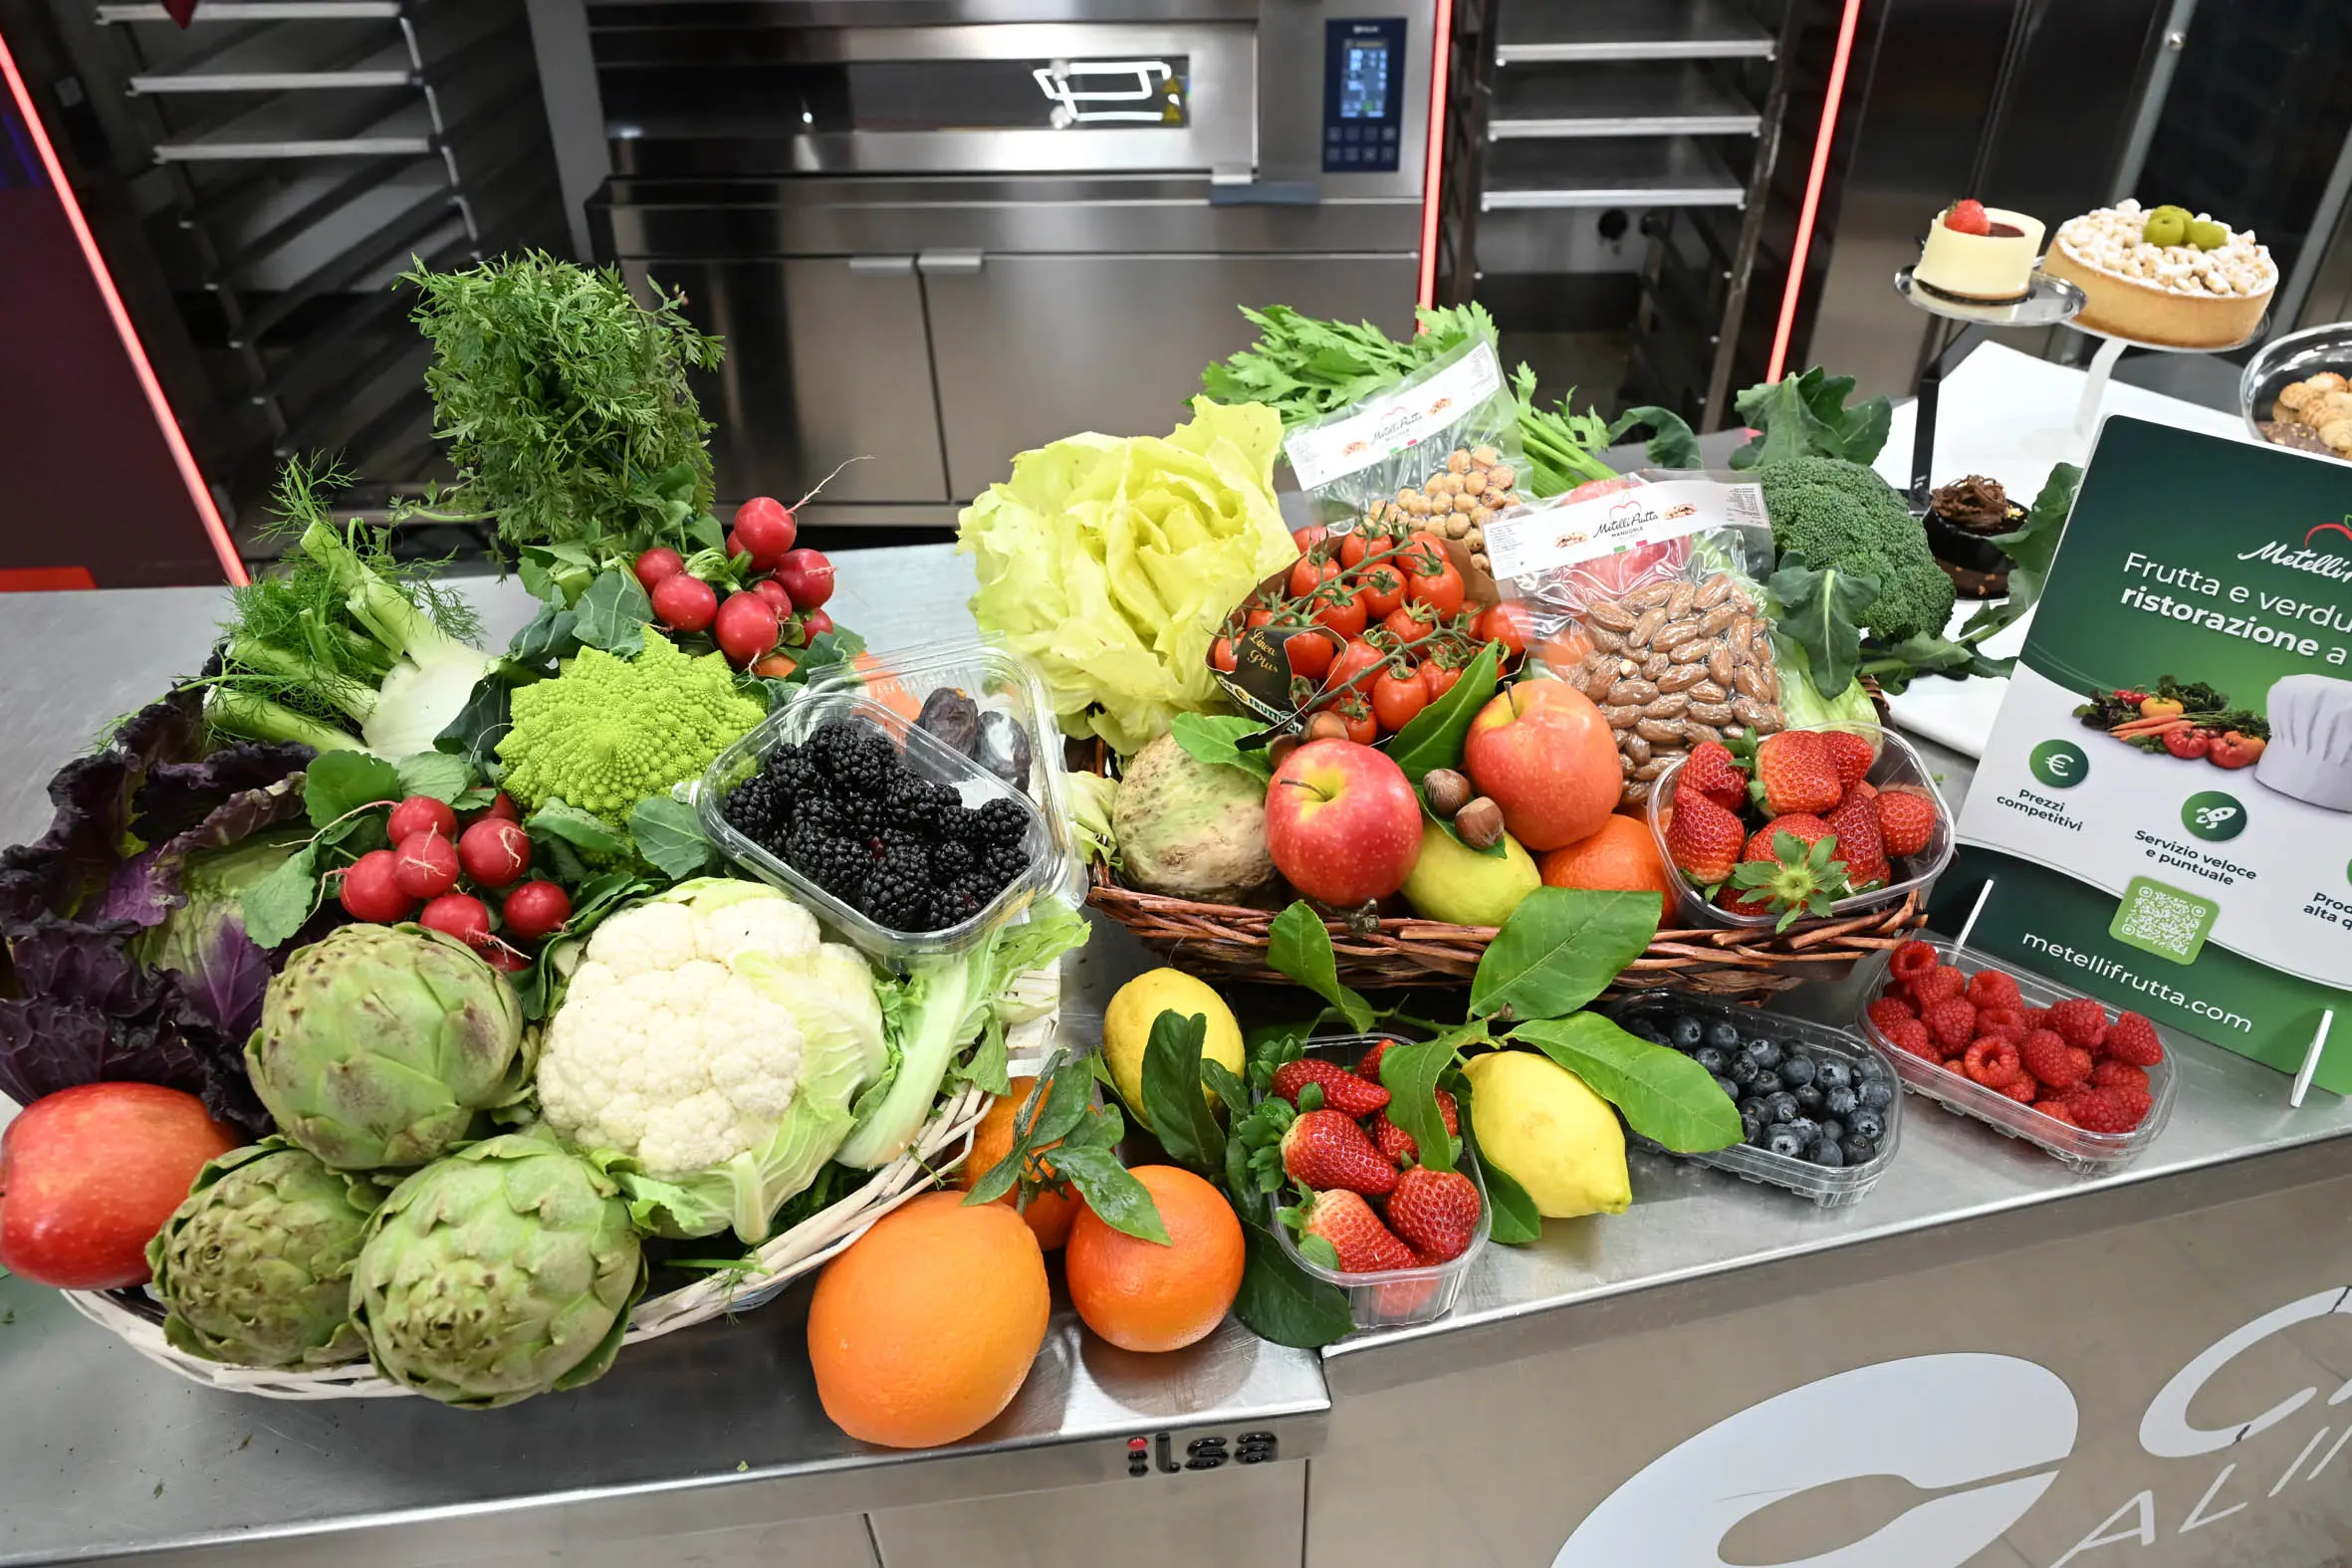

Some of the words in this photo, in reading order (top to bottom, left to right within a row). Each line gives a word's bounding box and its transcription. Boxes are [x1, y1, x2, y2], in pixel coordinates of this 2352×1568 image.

[1593, 517, 1630, 538] Metelli
[1631, 510, 1659, 526] Frutta
[2237, 541, 2350, 579] Metelli
[2123, 552, 2221, 596] Frutta
[2229, 585, 2250, 603] e
[2260, 591, 2352, 633] verdu
[1249, 629, 1276, 657] Linea
[2120, 585, 2319, 657] ristorazione
[2326, 647, 2348, 666] a
[1247, 649, 1279, 673] Plus
[1997, 795, 2083, 832] competitivi
[2018, 788, 2066, 813] Prezzi
[2134, 829, 2199, 859] Servizio
[2203, 854, 2257, 880] veloce
[2145, 848, 2156, 858] e
[2158, 853, 2234, 886] puntuale
[2302, 904, 2338, 924] alta
[2021, 932, 2253, 1034] metellifrutta.com
[1127, 1432, 1279, 1477] ilsa
